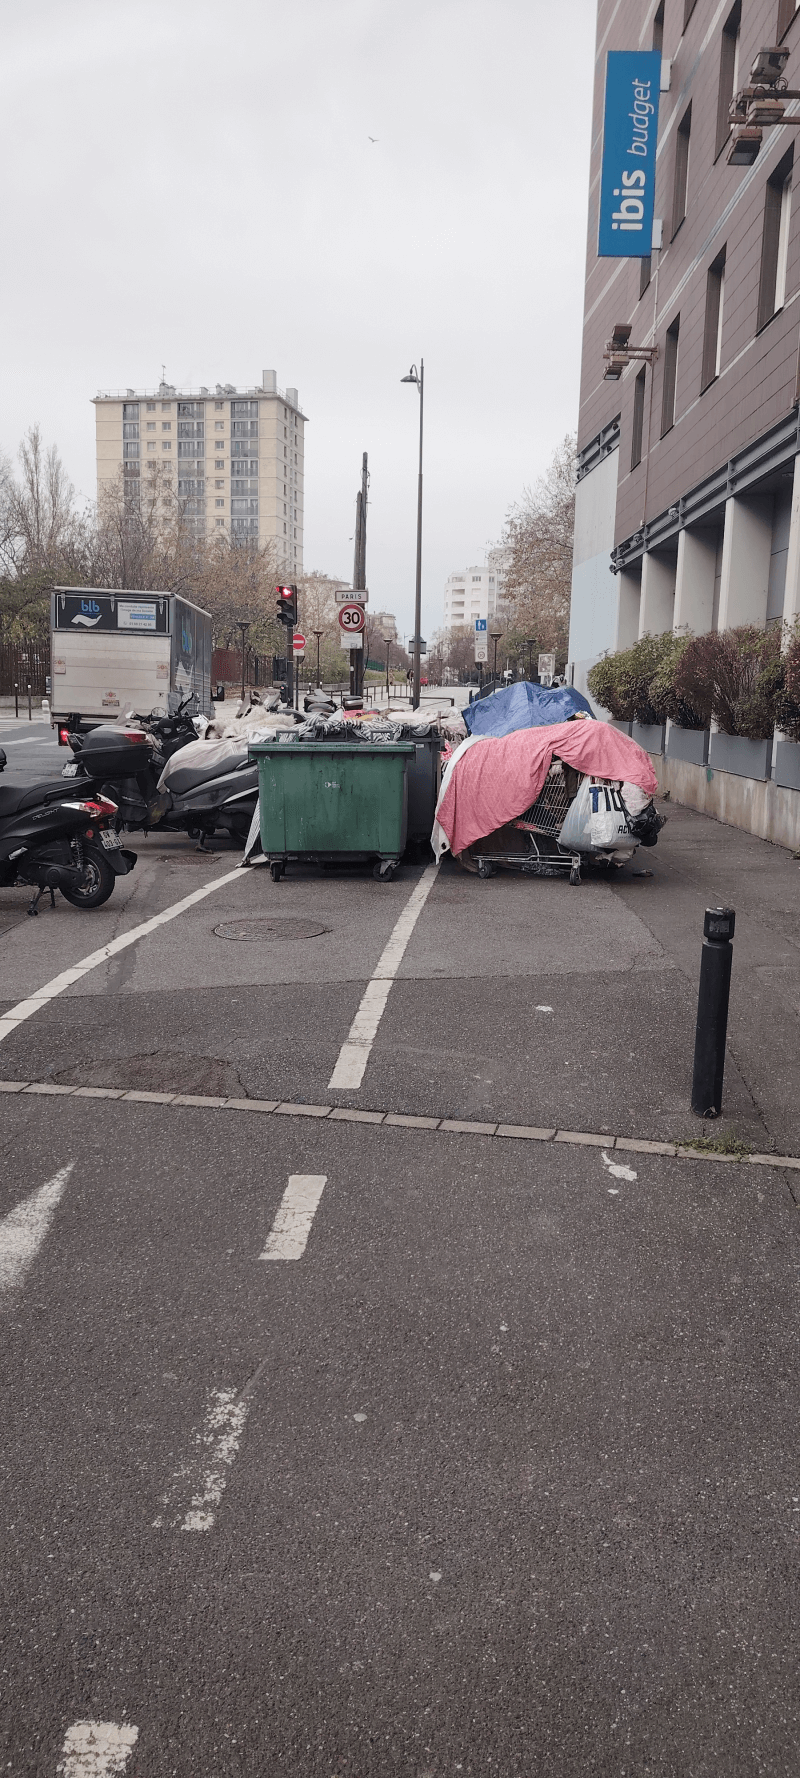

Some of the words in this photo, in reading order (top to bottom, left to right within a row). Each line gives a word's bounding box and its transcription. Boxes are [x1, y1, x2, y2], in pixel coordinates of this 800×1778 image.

[626, 78, 655, 157] budget
[611, 169, 646, 231] ibis
[81, 599, 100, 612] blb
[343, 611, 361, 625] 30
